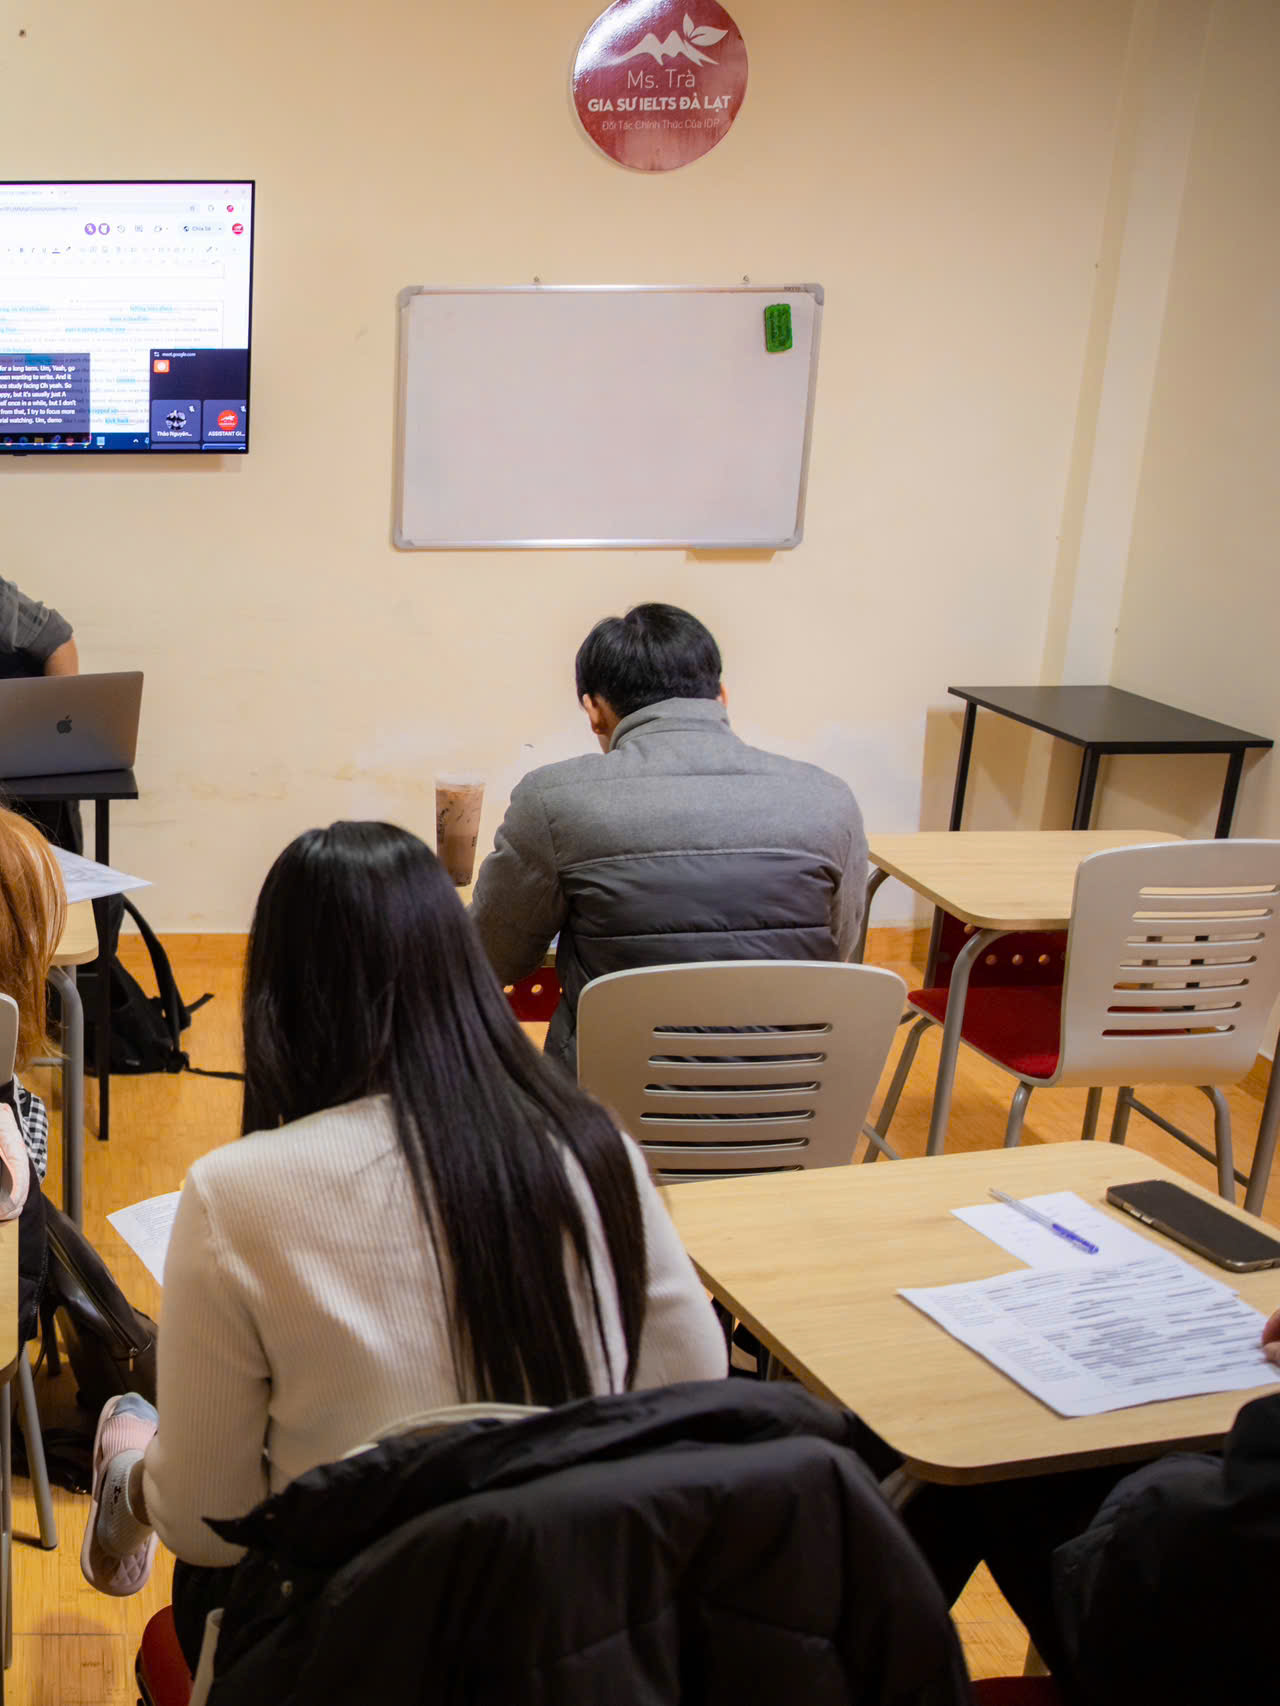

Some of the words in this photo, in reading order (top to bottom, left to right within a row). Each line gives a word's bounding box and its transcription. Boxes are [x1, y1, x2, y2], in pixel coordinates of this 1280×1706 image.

[627, 70, 660, 89] Ms.
[665, 68, 696, 88] Trà
[588, 97, 614, 112] GIA
[616, 96, 637, 111] SƯ
[640, 96, 676, 111] IELTS
[679, 92, 700, 110] ĐÀ
[704, 95, 731, 112] LẠT
